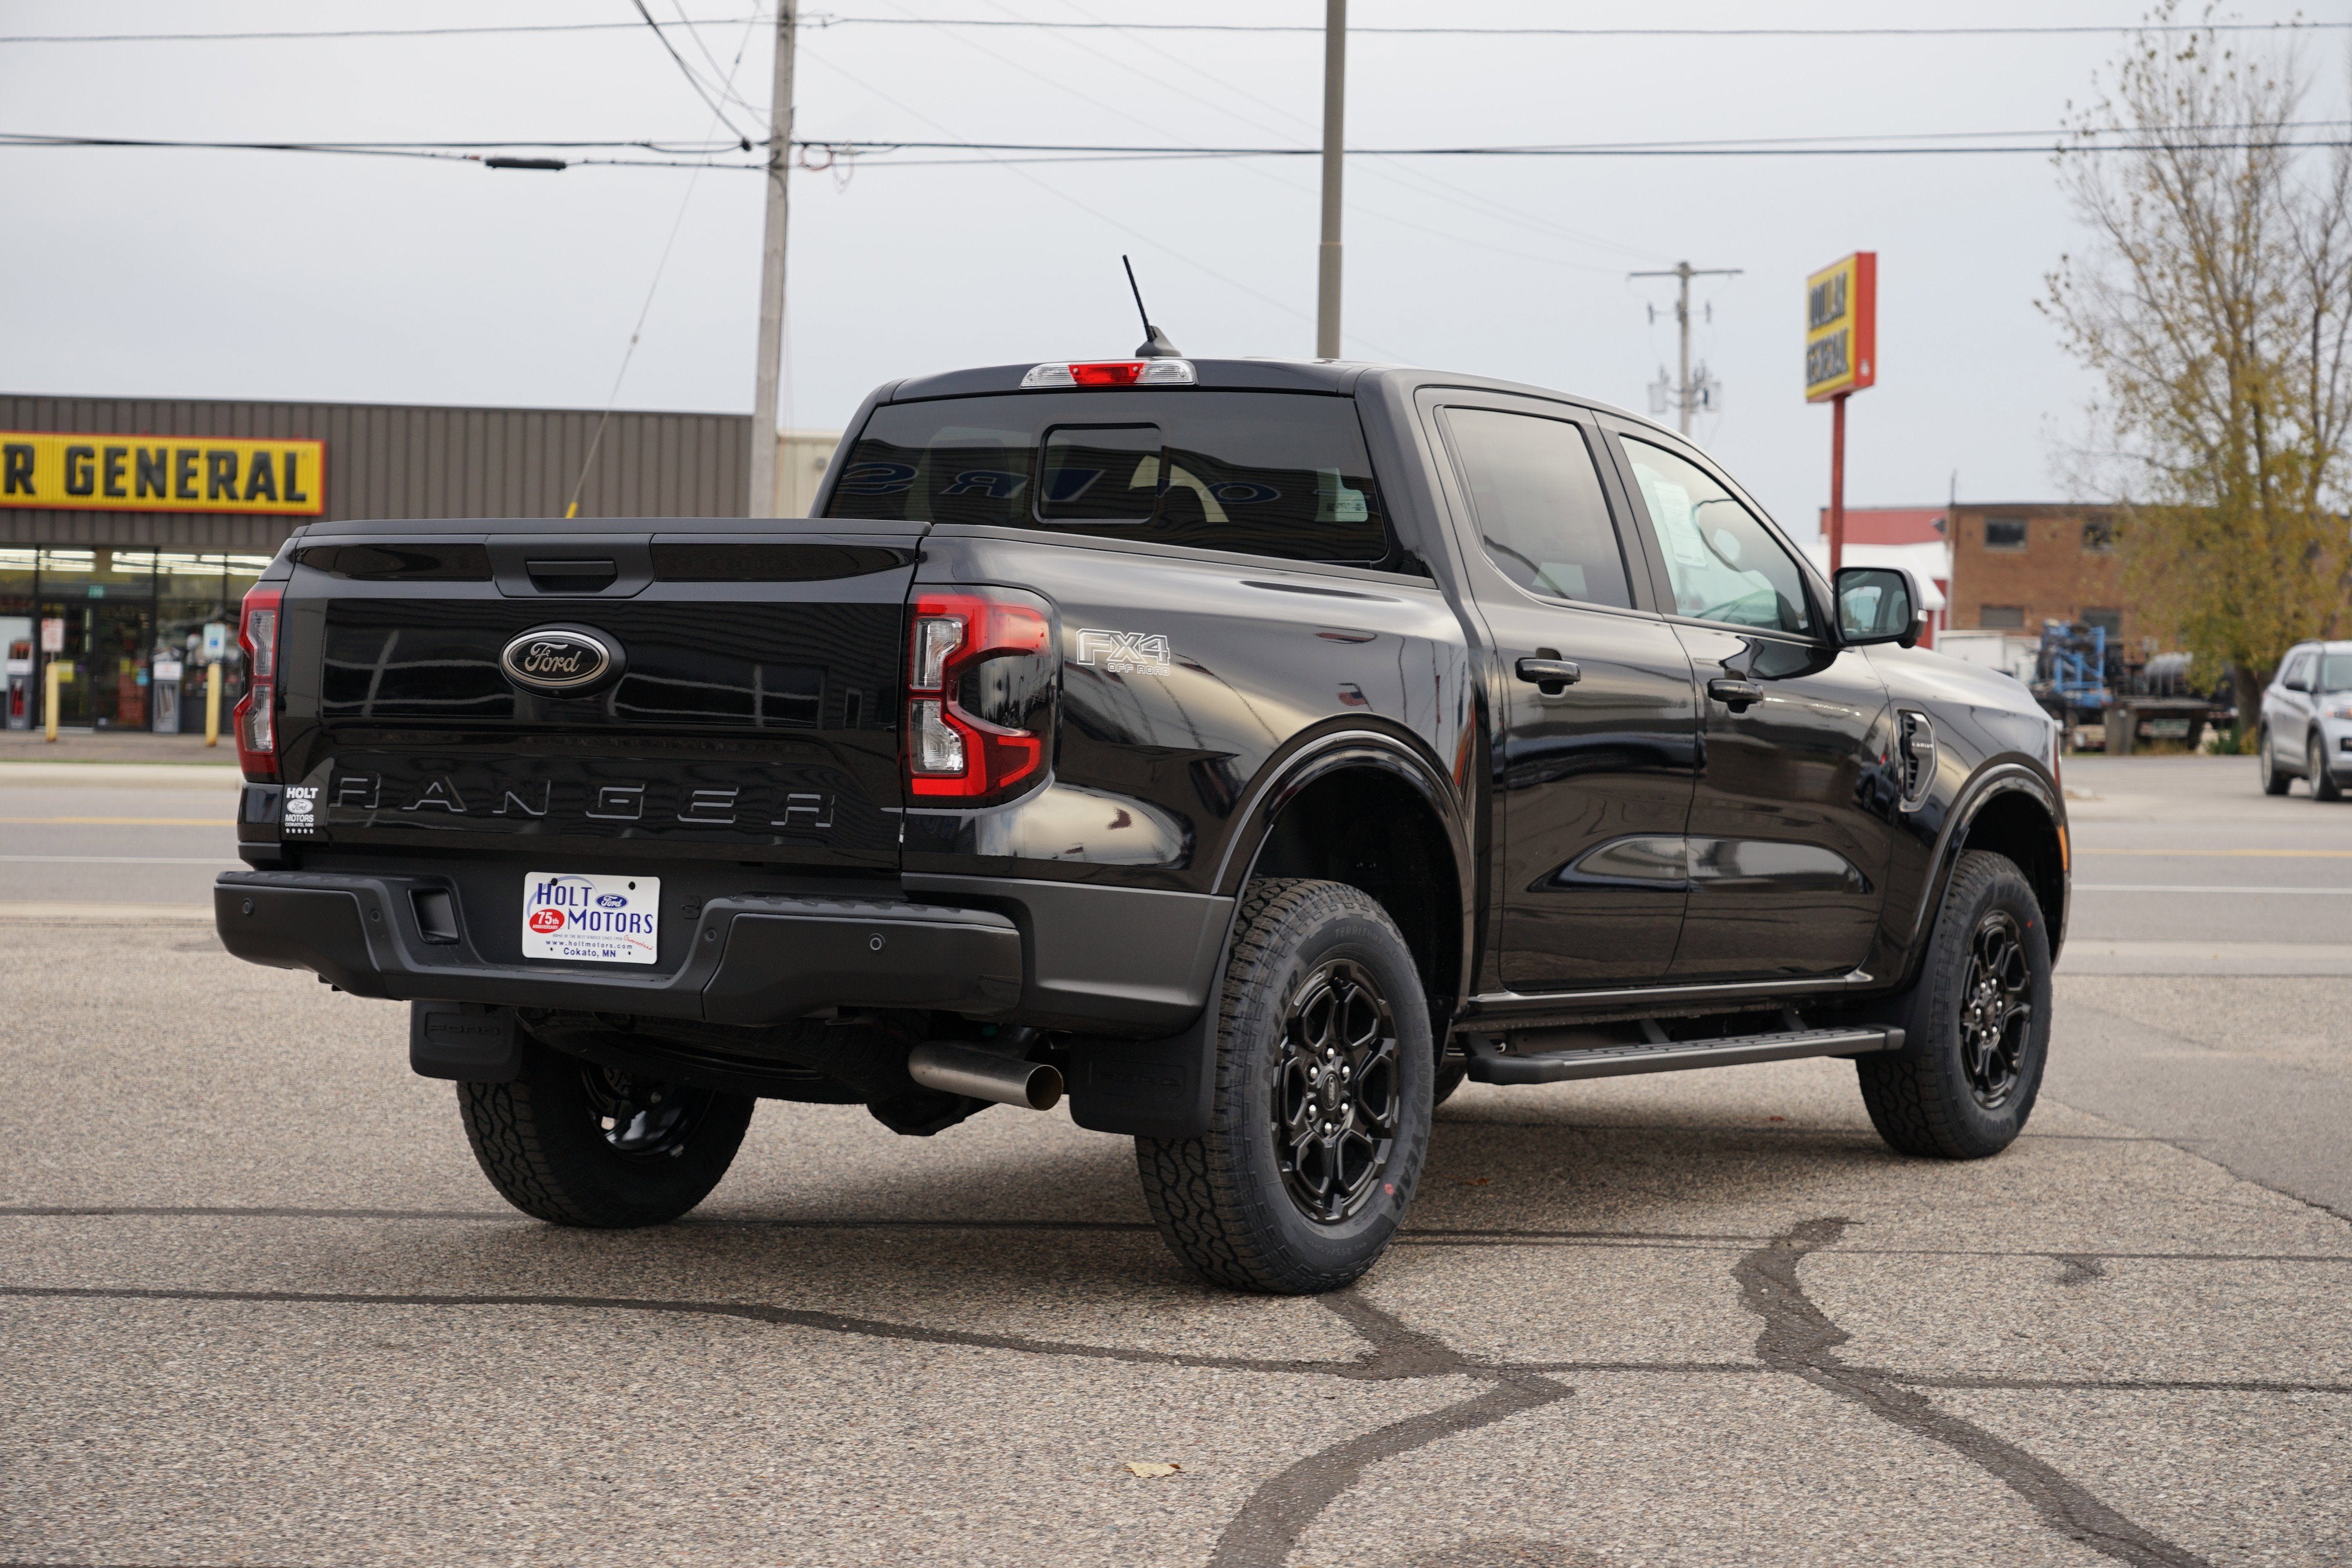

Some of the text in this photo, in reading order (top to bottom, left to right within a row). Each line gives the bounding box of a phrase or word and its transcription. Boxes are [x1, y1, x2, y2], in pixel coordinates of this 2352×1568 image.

[66, 445, 307, 501] GENERAL
[1076, 628, 1170, 666] FX4
[524, 642, 582, 673] Ford
[1107, 662, 1170, 676] OFF ROAD
[286, 787, 318, 799] HOLT
[328, 774, 835, 827] RANGER
[292, 801, 307, 811] Ford
[285, 814, 314, 822] MOTORS
[537, 883, 592, 907] HOLT
[601, 896, 623, 908] Ford
[537, 911, 560, 926] 75th
[568, 908, 653, 934] MOTORS
[546, 939, 633, 950] www.holtmotors.com
[564, 948, 599, 958] Cokato,
[1392, 1018, 1431, 1211] GOODYEAR
